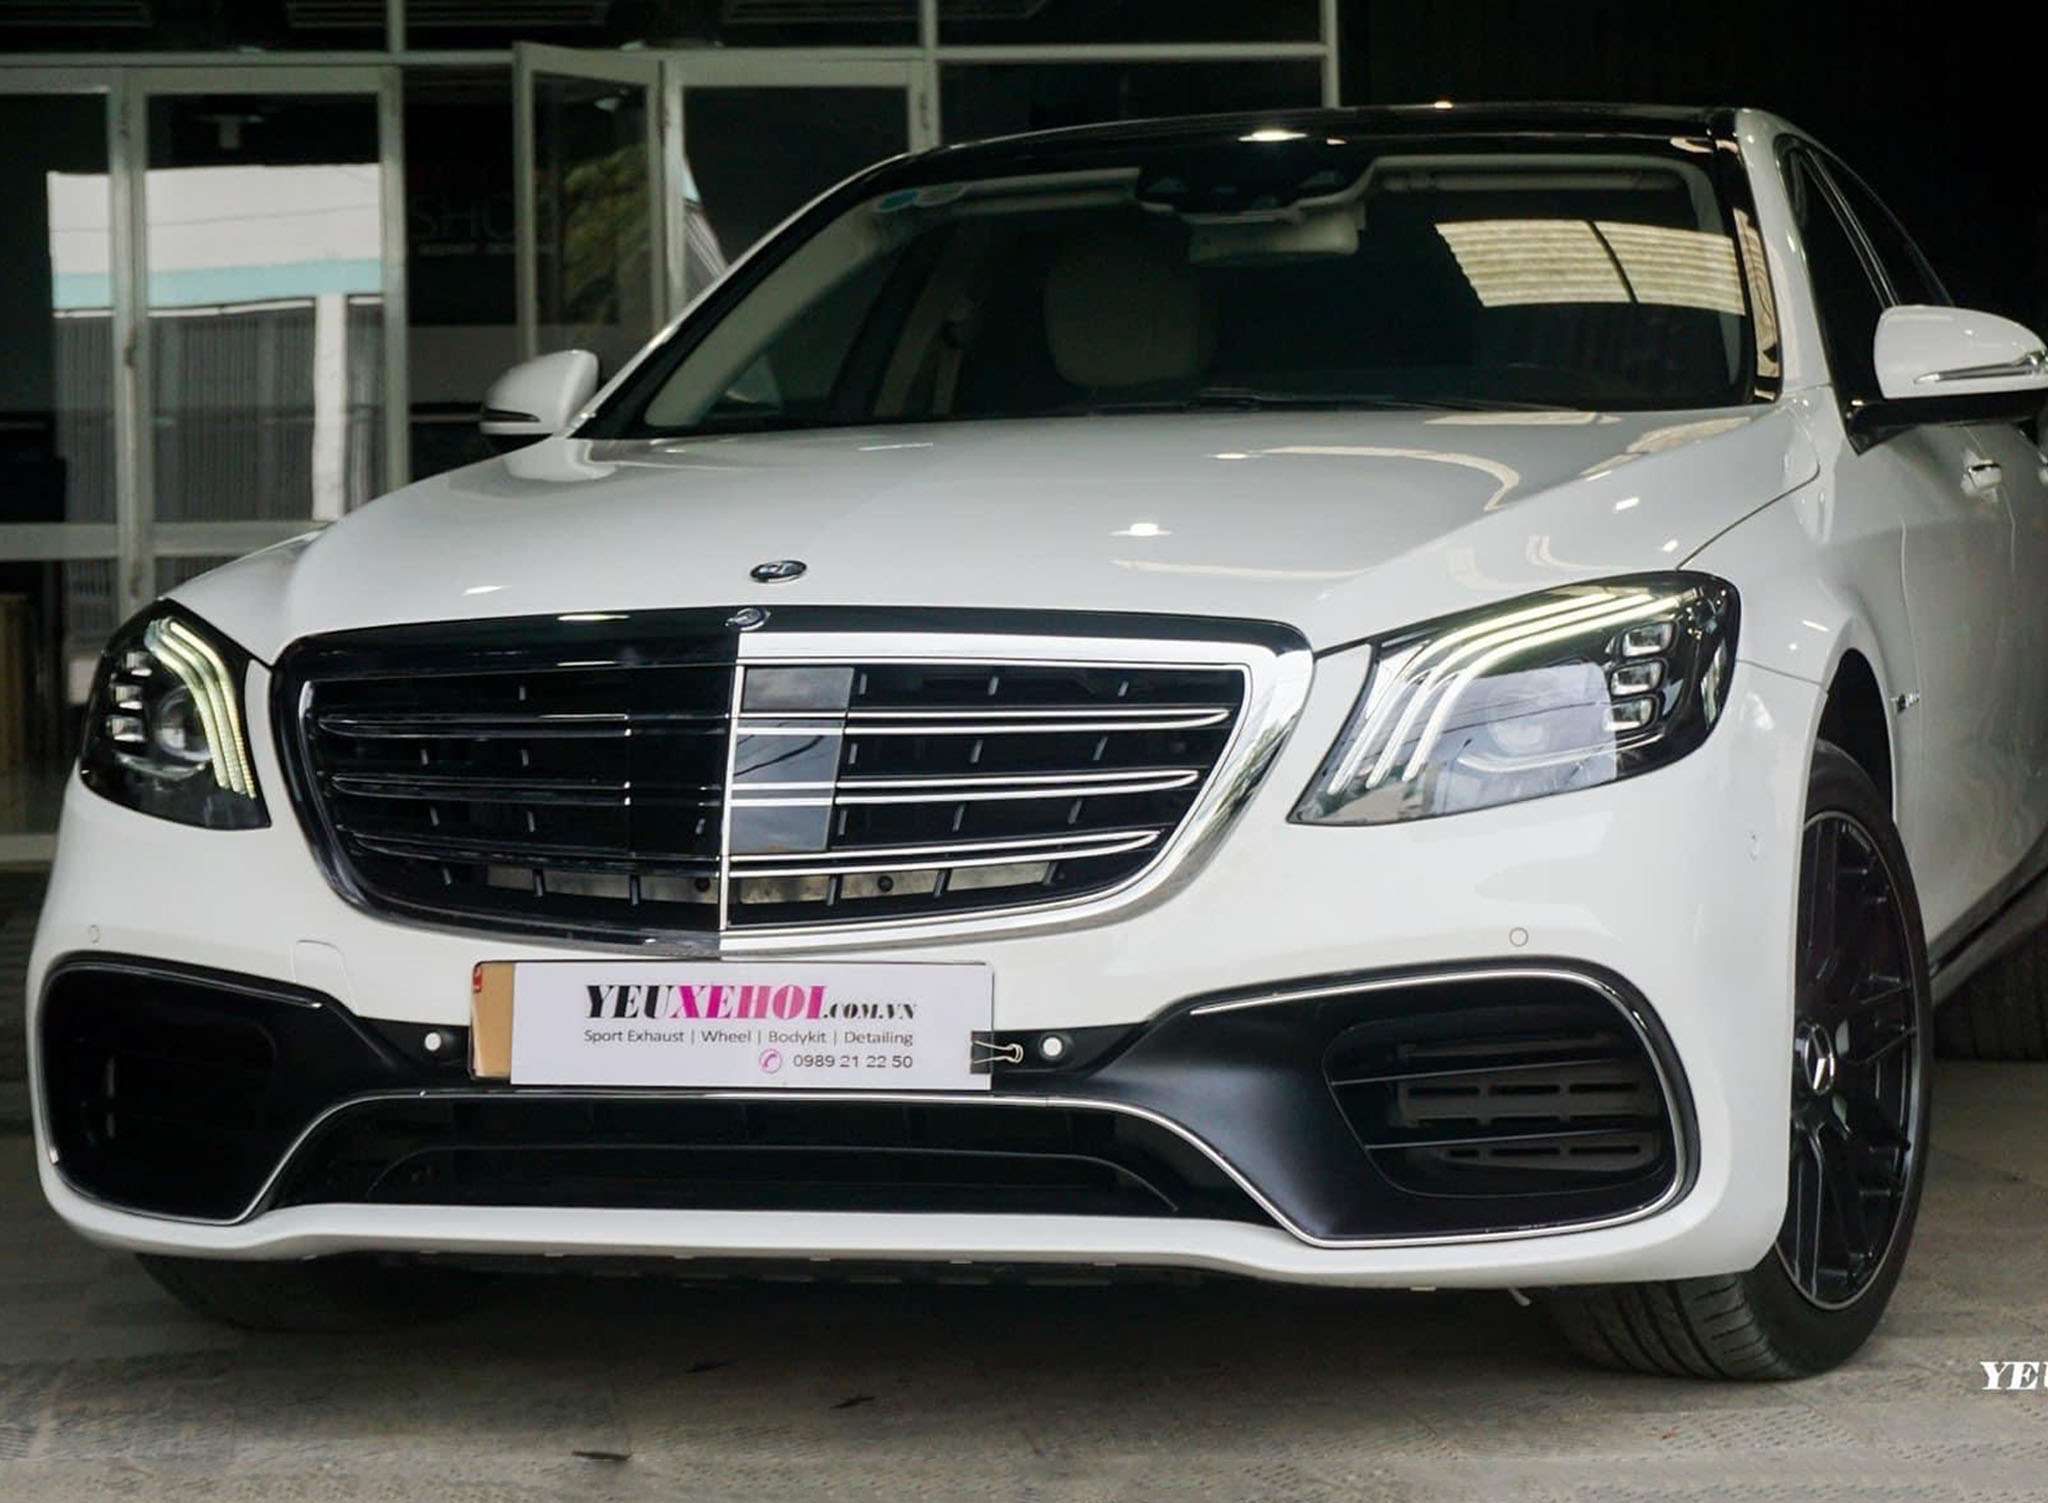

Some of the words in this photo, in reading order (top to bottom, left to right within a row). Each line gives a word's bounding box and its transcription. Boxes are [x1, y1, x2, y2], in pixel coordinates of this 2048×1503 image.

[585, 1029, 623, 1043] Sport
[627, 1029, 684, 1043] Exhaust
[702, 1030, 751, 1043] Wheel
[768, 1030, 827, 1045] Bodykit
[844, 1031, 913, 1046] Detailing
[793, 1054, 835, 1067] 0989
[840, 1055, 859, 1067] 21
[866, 1056, 887, 1067] 22
[892, 1055, 913, 1068] 50
